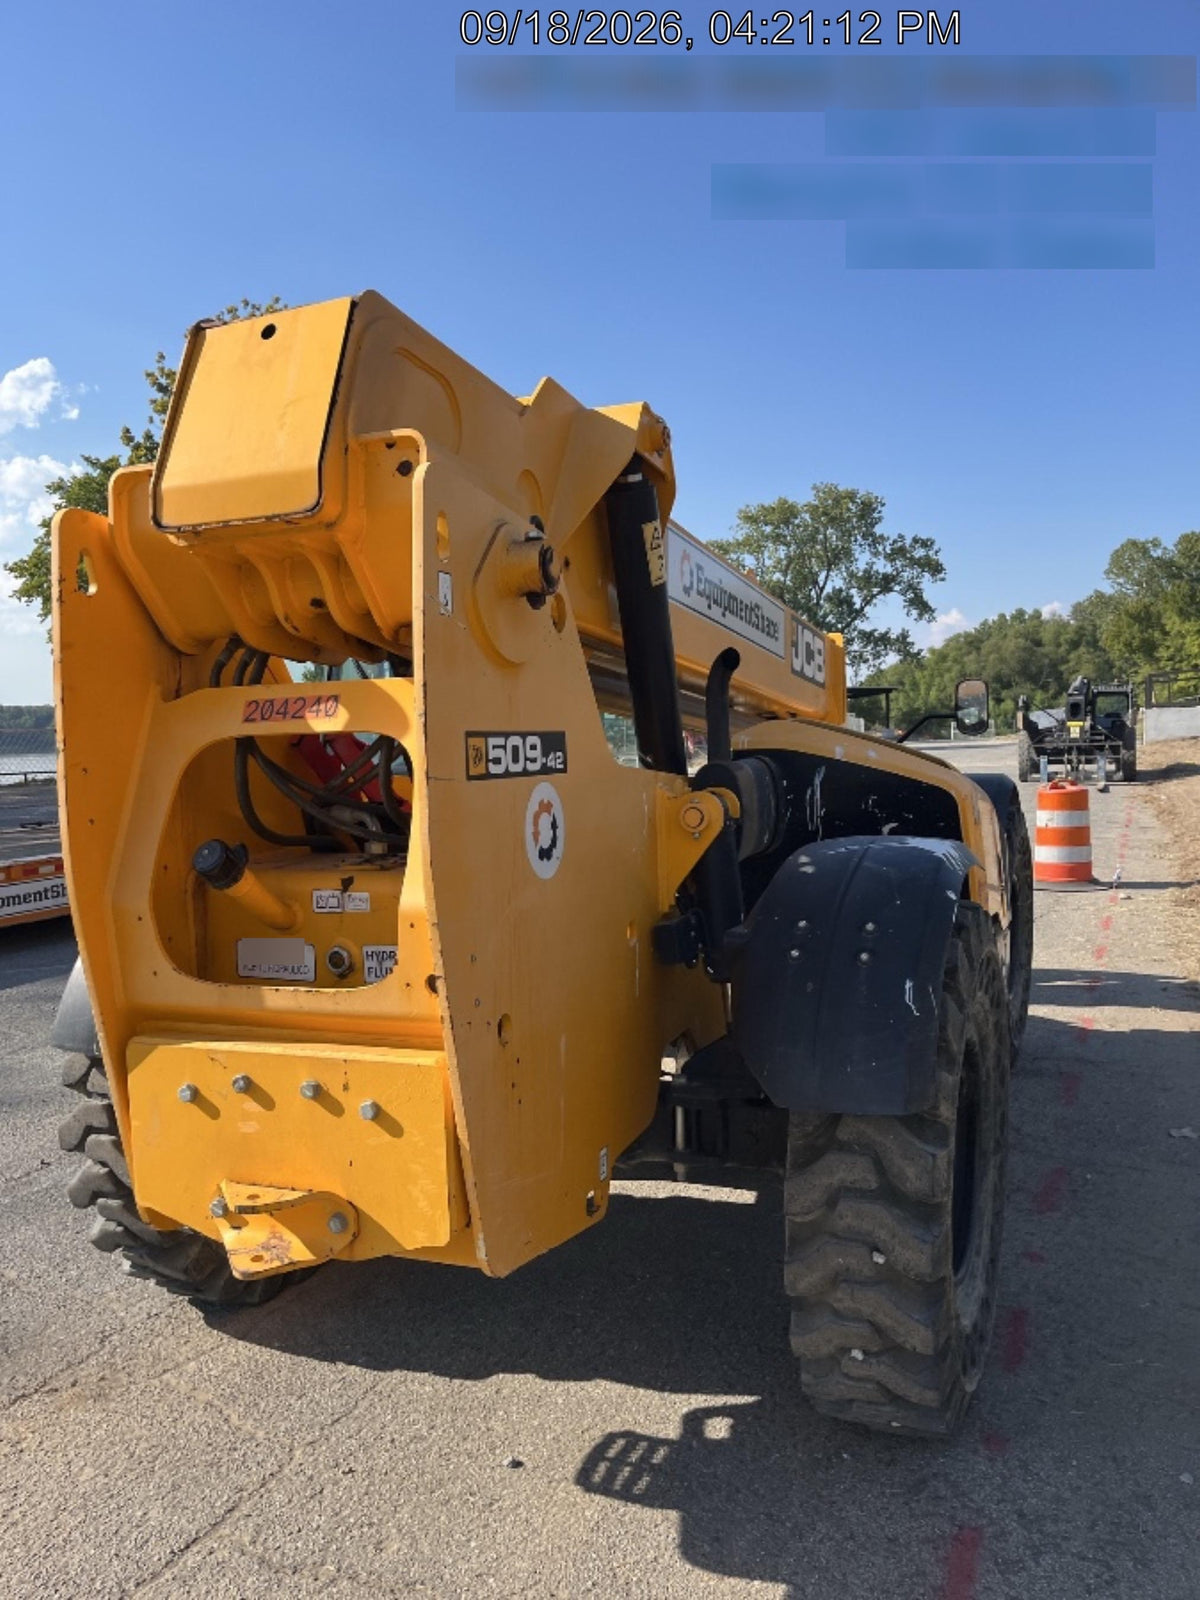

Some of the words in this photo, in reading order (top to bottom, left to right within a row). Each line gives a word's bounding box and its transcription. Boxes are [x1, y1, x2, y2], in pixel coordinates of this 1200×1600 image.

[695, 561, 779, 642] EquipmentShare
[791, 621, 826, 684] JCB
[243, 694, 339, 722] 204240
